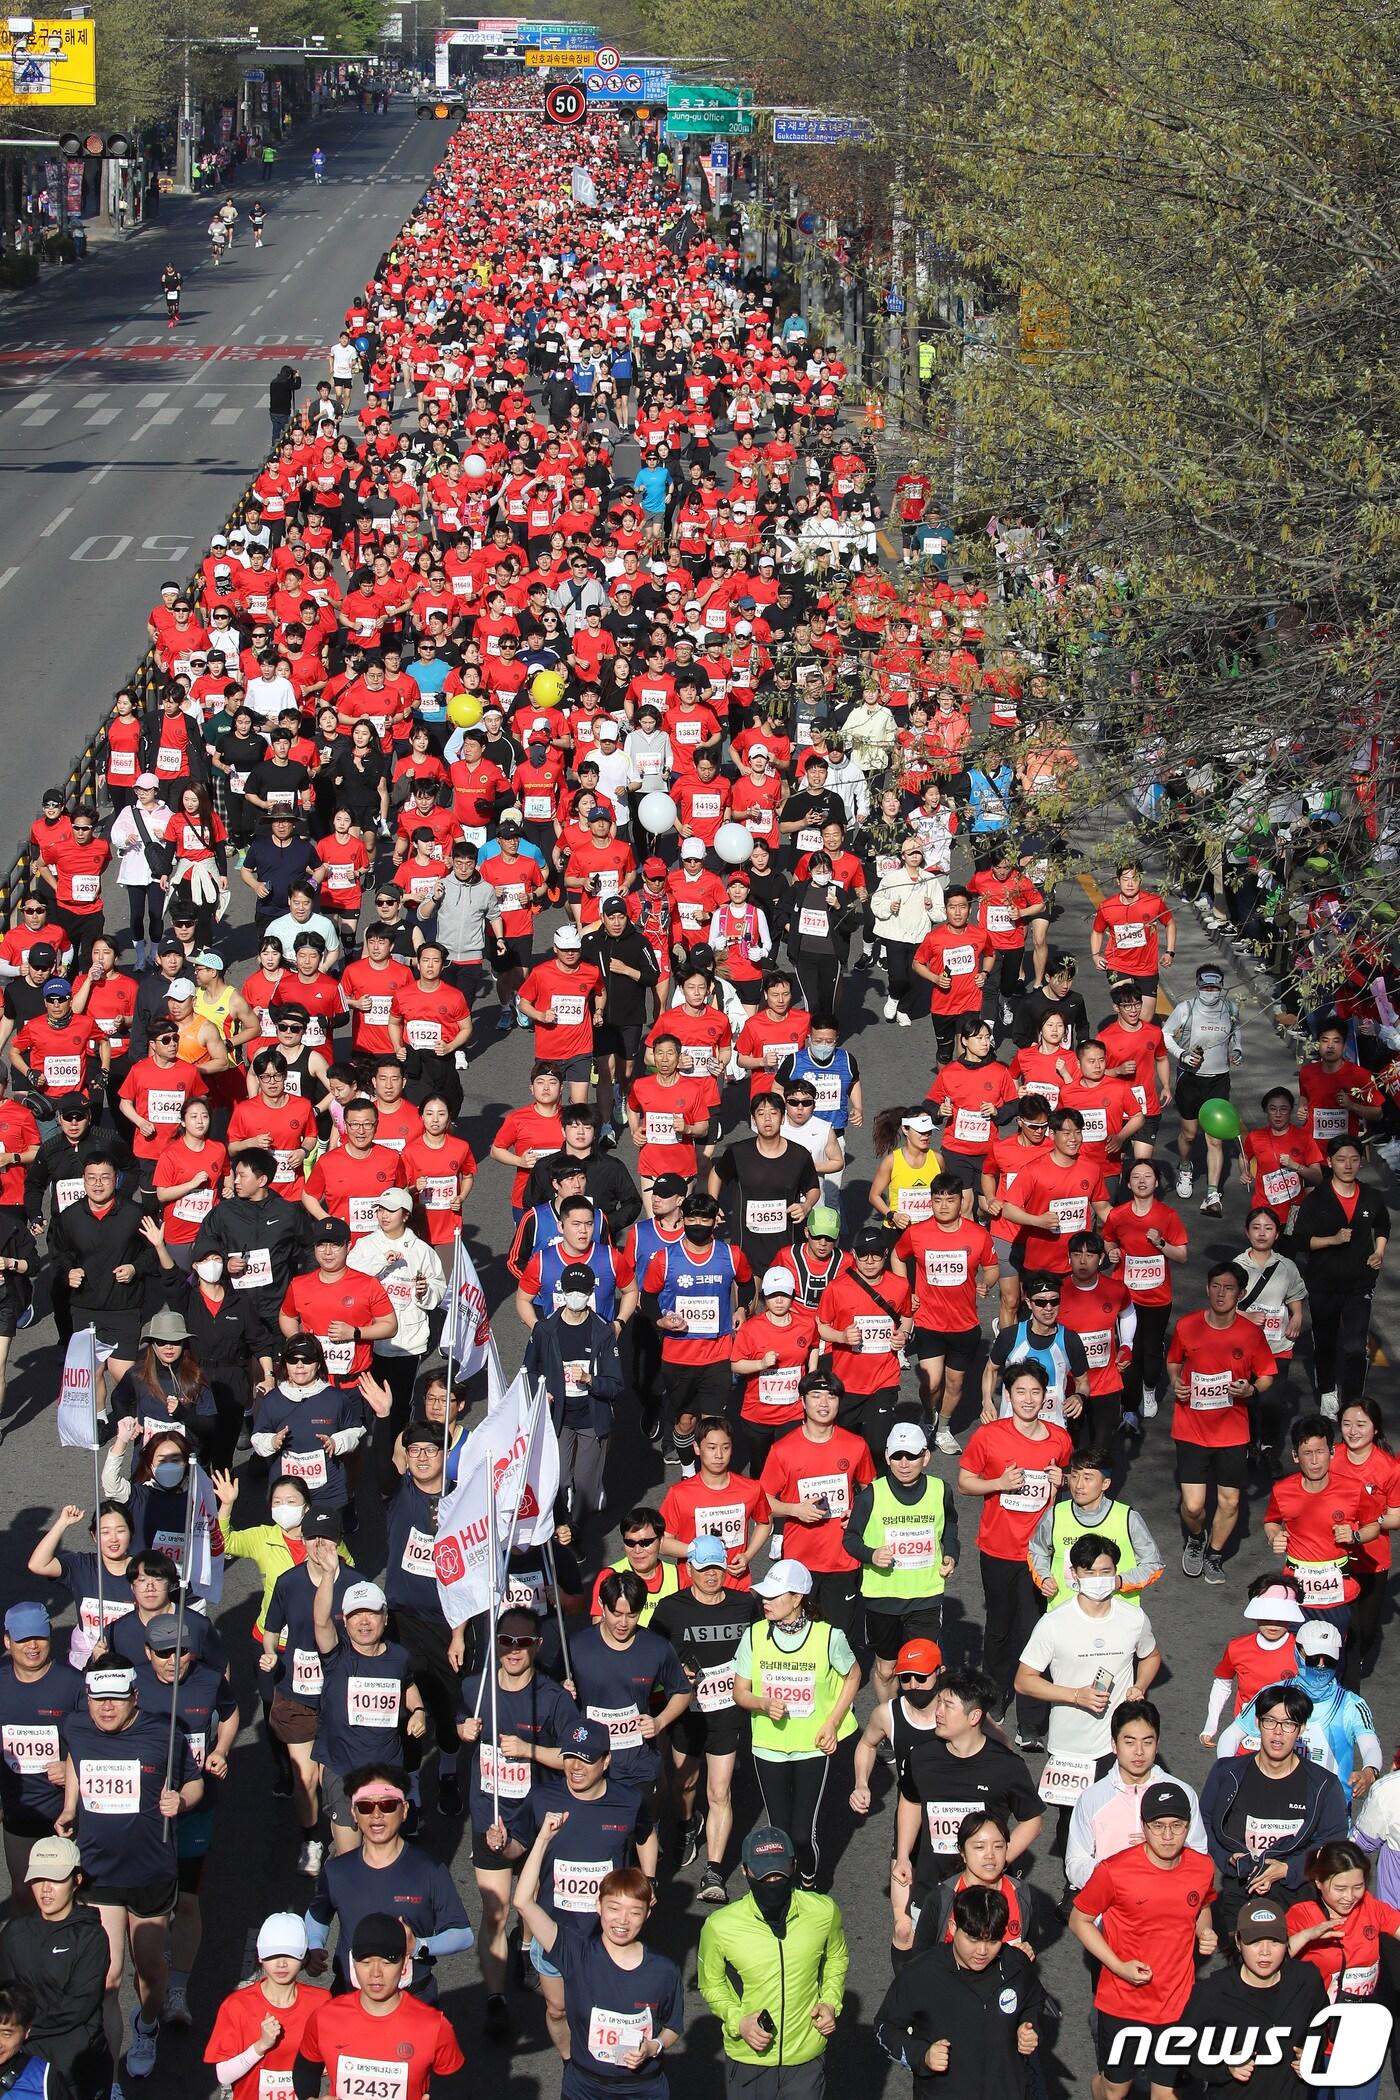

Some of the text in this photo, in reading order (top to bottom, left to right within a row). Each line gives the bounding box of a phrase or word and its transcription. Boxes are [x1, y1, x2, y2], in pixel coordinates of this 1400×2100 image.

[531, 54, 590, 64] 신호과속단속장비
[601, 52, 615, 66] 50
[556, 96, 576, 113] 50
[672, 112, 725, 122] Jung-gu Office
[729, 123, 749, 132] 200m
[113, 759, 132, 767] 16657
[159, 756, 179, 764] 13660
[801, 834, 822, 844] 14743
[76, 882, 97, 892] 12637
[946, 955, 972, 965] 13202
[554, 1005, 581, 1015] 12236
[410, 1031, 438, 1040] 11522
[48, 1066, 78, 1075] 13066
[152, 1102, 181, 1112] 13642
[649, 1123, 673, 1133] 1337
[959, 1120, 987, 1131] 17372
[1317, 1118, 1345, 1128] 10958
[178, 1199, 209, 1211] 17137
[750, 1211, 783, 1222] 13653
[929, 1263, 964, 1273] 14159
[1128, 1267, 1162, 1278] 17290
[696, 1275, 722, 1285] 크레텍
[680, 1310, 715, 1320] 10859
[763, 1380, 798, 1392] 17749
[1194, 1384, 1228, 1398] 14525
[882, 1515, 936, 1525] 영남대학교병원
[890, 1540, 932, 1555] 16294
[1300, 1578, 1339, 1592] 11644
[684, 1625, 743, 1642] ASICS
[760, 1660, 816, 1671] 영남대학교병원
[94, 1673, 126, 1681] TaylorMade
[765, 1686, 811, 1701] 16296
[352, 1694, 396, 1709] 10195
[7, 1742, 54, 1756] 10198
[1045, 1771, 1089, 1789] 10850
[86, 1779, 133, 1794] 13181
[342, 2077, 401, 2100] 12437
